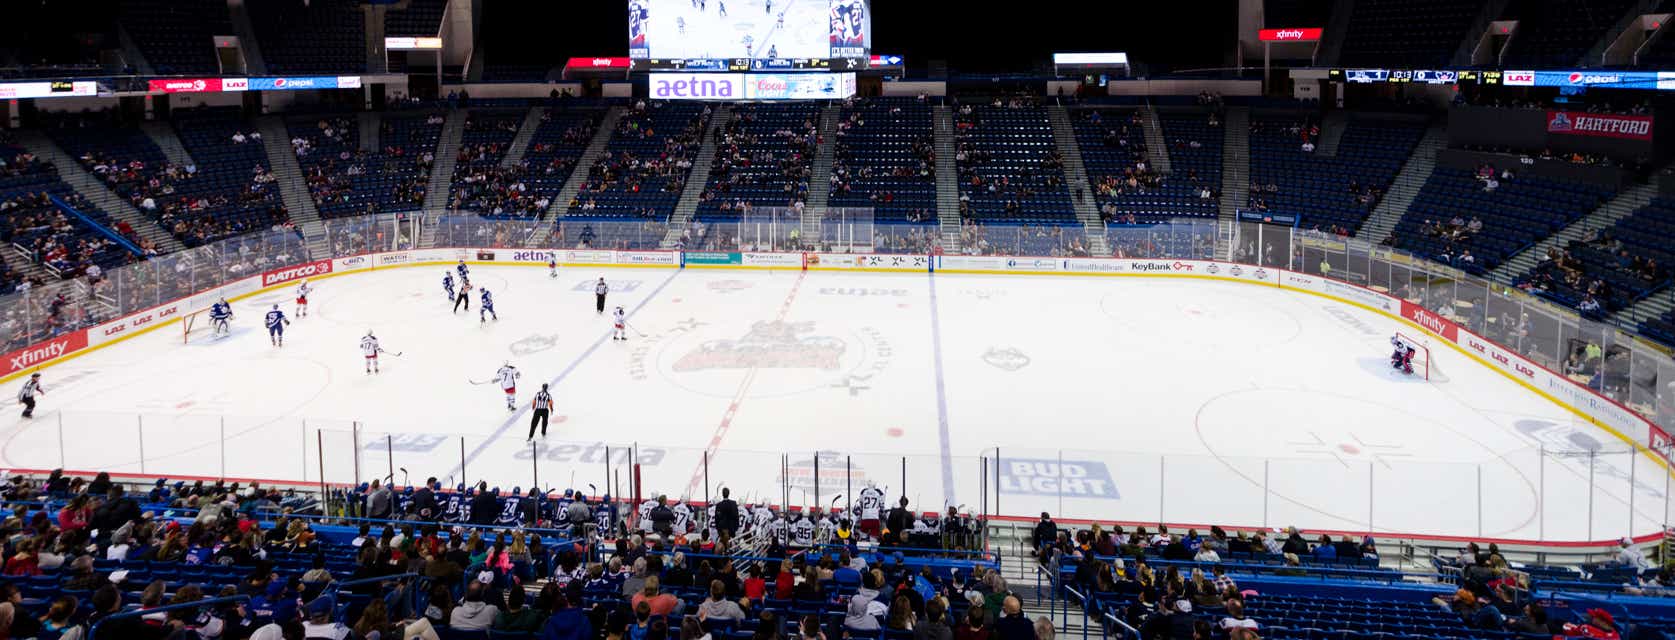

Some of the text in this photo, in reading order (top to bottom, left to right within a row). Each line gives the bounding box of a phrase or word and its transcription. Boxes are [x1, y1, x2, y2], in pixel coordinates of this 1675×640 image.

[1276, 30, 1304, 40] xfinity
[288, 80, 314, 90] pepsi
[657, 76, 732, 97] aetna
[757, 79, 787, 91] Coors
[1582, 75, 1619, 84] pepsi
[1575, 117, 1650, 135] HARTFORD
[1131, 262, 1171, 272] KeyBank
[265, 266, 317, 284] DATTCO
[160, 307, 178, 319] LAZ
[133, 314, 153, 327] LAZ
[1412, 309, 1446, 335] xfinity
[105, 324, 126, 337] LAZ
[1469, 339, 1486, 353] LAZ
[10, 339, 69, 370] xfinity
[1491, 351, 1509, 366] LAZ
[1515, 363, 1534, 378] LAZ
[512, 440, 667, 467] aetna
[1011, 461, 1087, 479] BUD
[998, 475, 1107, 496] LIGHT
[502, 503, 518, 517] 24
[863, 497, 879, 509] 27
